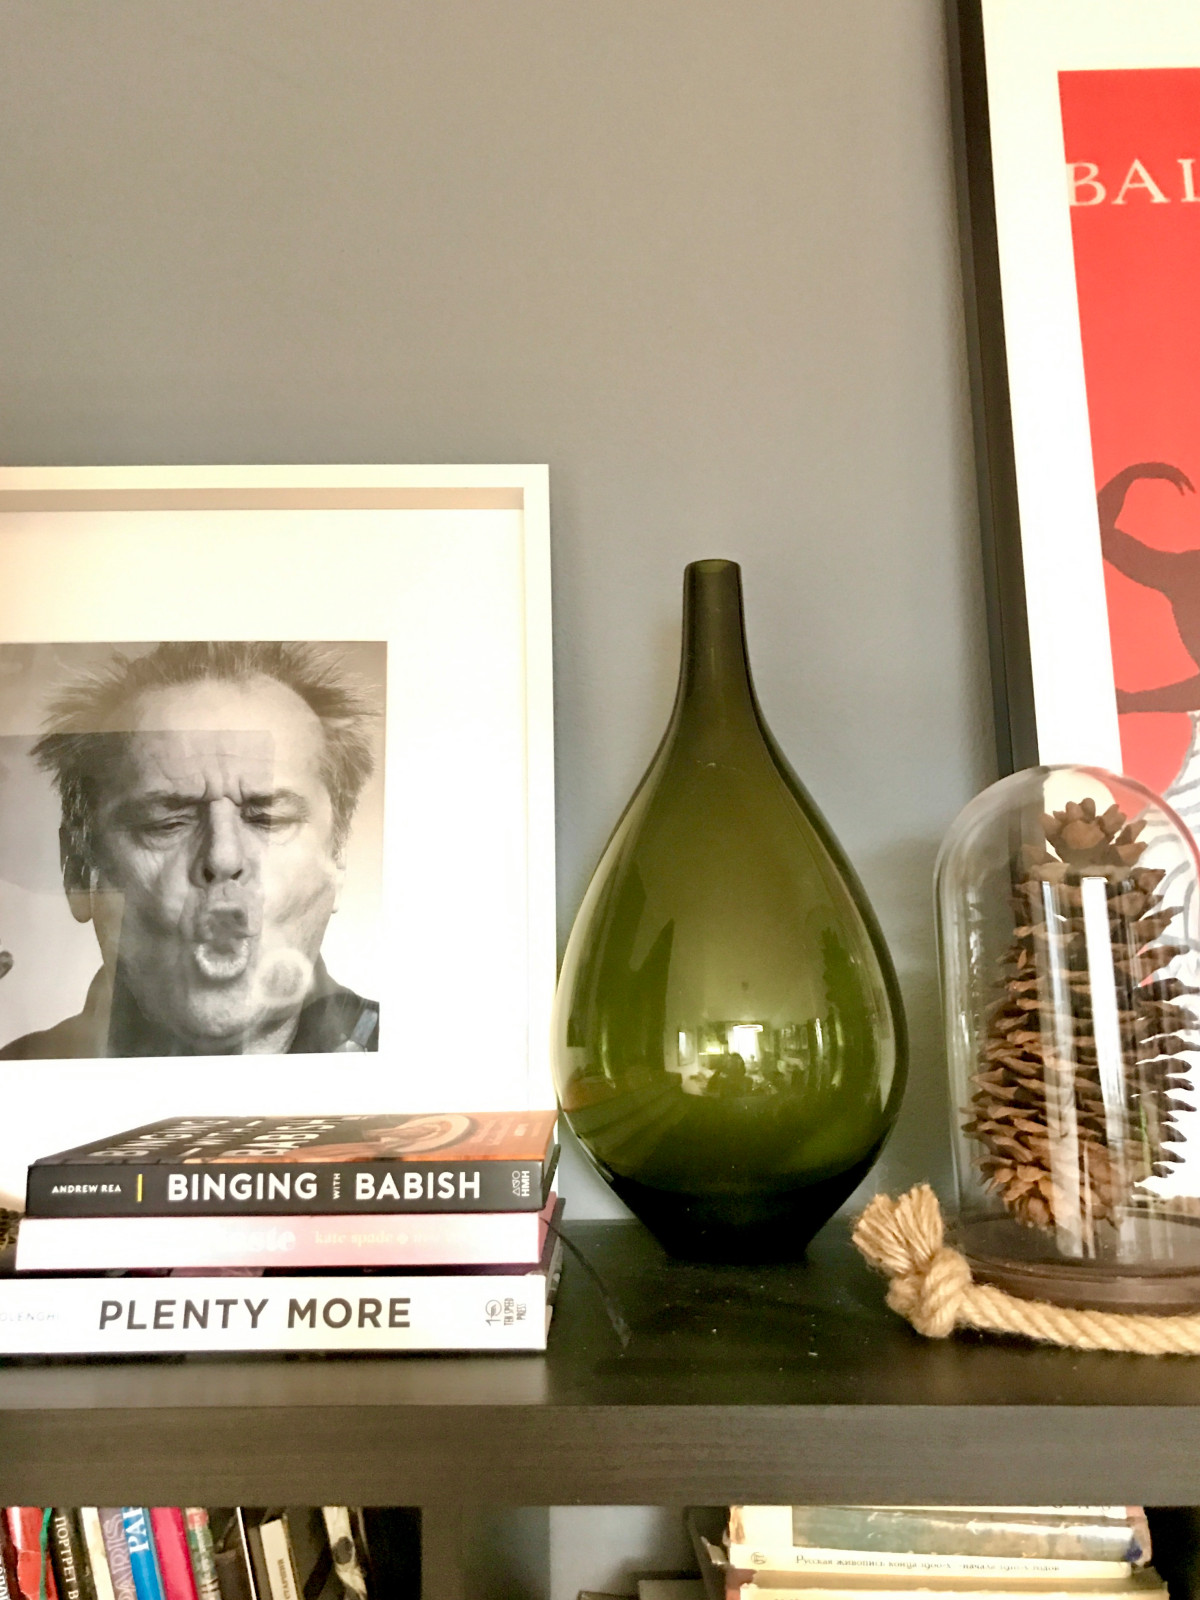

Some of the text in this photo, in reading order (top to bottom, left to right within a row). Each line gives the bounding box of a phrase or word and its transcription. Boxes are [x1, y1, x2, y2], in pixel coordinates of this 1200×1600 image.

[87, 1120, 231, 1157] BINGING
[217, 1118, 345, 1157] BABISH
[51, 1184, 123, 1194] ANDREW REA
[167, 1171, 481, 1201] BINGING WITH BABISH
[521, 1170, 530, 1197] HMH
[314, 1230, 346, 1244] kate
[351, 1230, 394, 1248] spade
[99, 1297, 411, 1330] PLENTY MORE
[54, 1515, 78, 1583] ПОРТРЕТ
[796, 1554, 833, 1566] Русская
[836, 1559, 886, 1567] живопись
